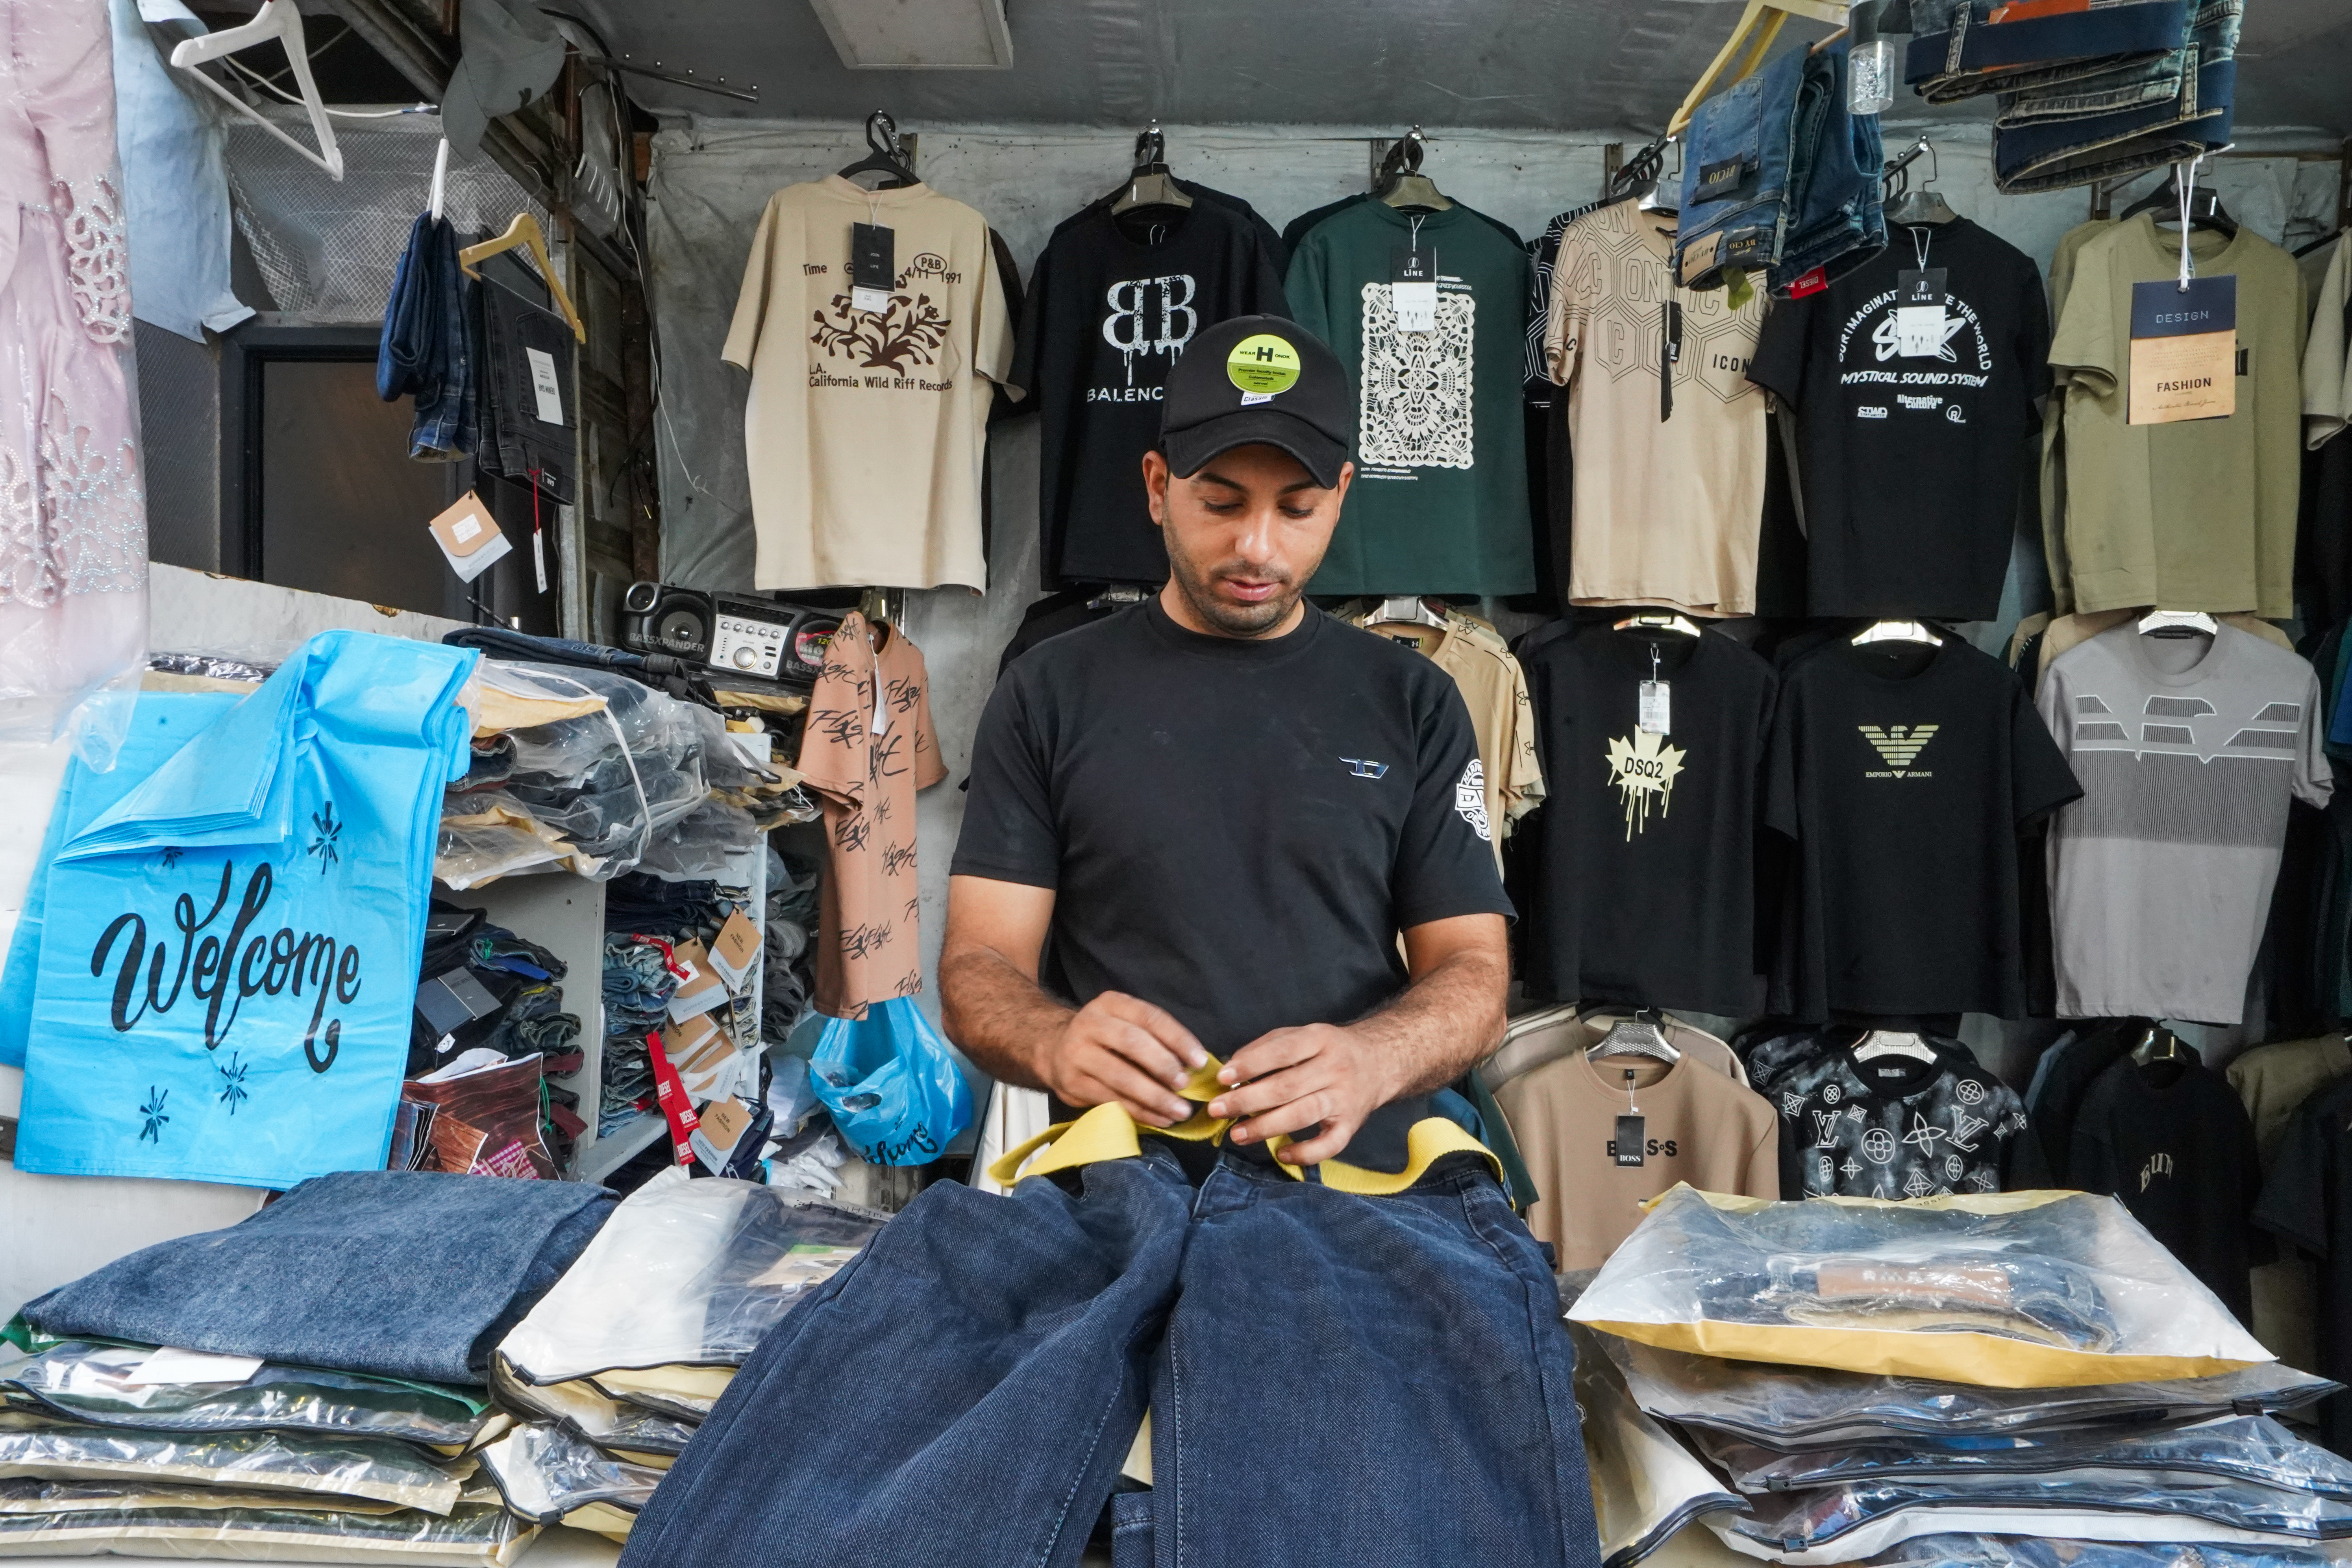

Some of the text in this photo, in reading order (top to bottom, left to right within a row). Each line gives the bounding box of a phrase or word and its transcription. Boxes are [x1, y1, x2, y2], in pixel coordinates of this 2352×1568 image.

[803, 263, 827, 276] Time
[921, 257, 942, 270] P&B
[940, 270, 962, 283] 1991
[2156, 310, 2209, 324] DESIGN
[1256, 346, 1274, 362] H
[809, 363, 827, 375] L.A.
[809, 375, 953, 392] California Wild Riff Records
[1841, 370, 1989, 387] MYSTICAL SOUND SYSTEM
[2157, 377, 2212, 392] FASHION
[1086, 387, 1164, 403] BALENC
[1624, 756, 1663, 779] DSQ2
[90, 859, 362, 1074] Welcome
[679, 1109, 696, 1125] DIESEL
[714, 1113, 731, 1133] FASHION
[721, 1112, 730, 1124] NEW
[677, 1141, 692, 1157] DIESEL
